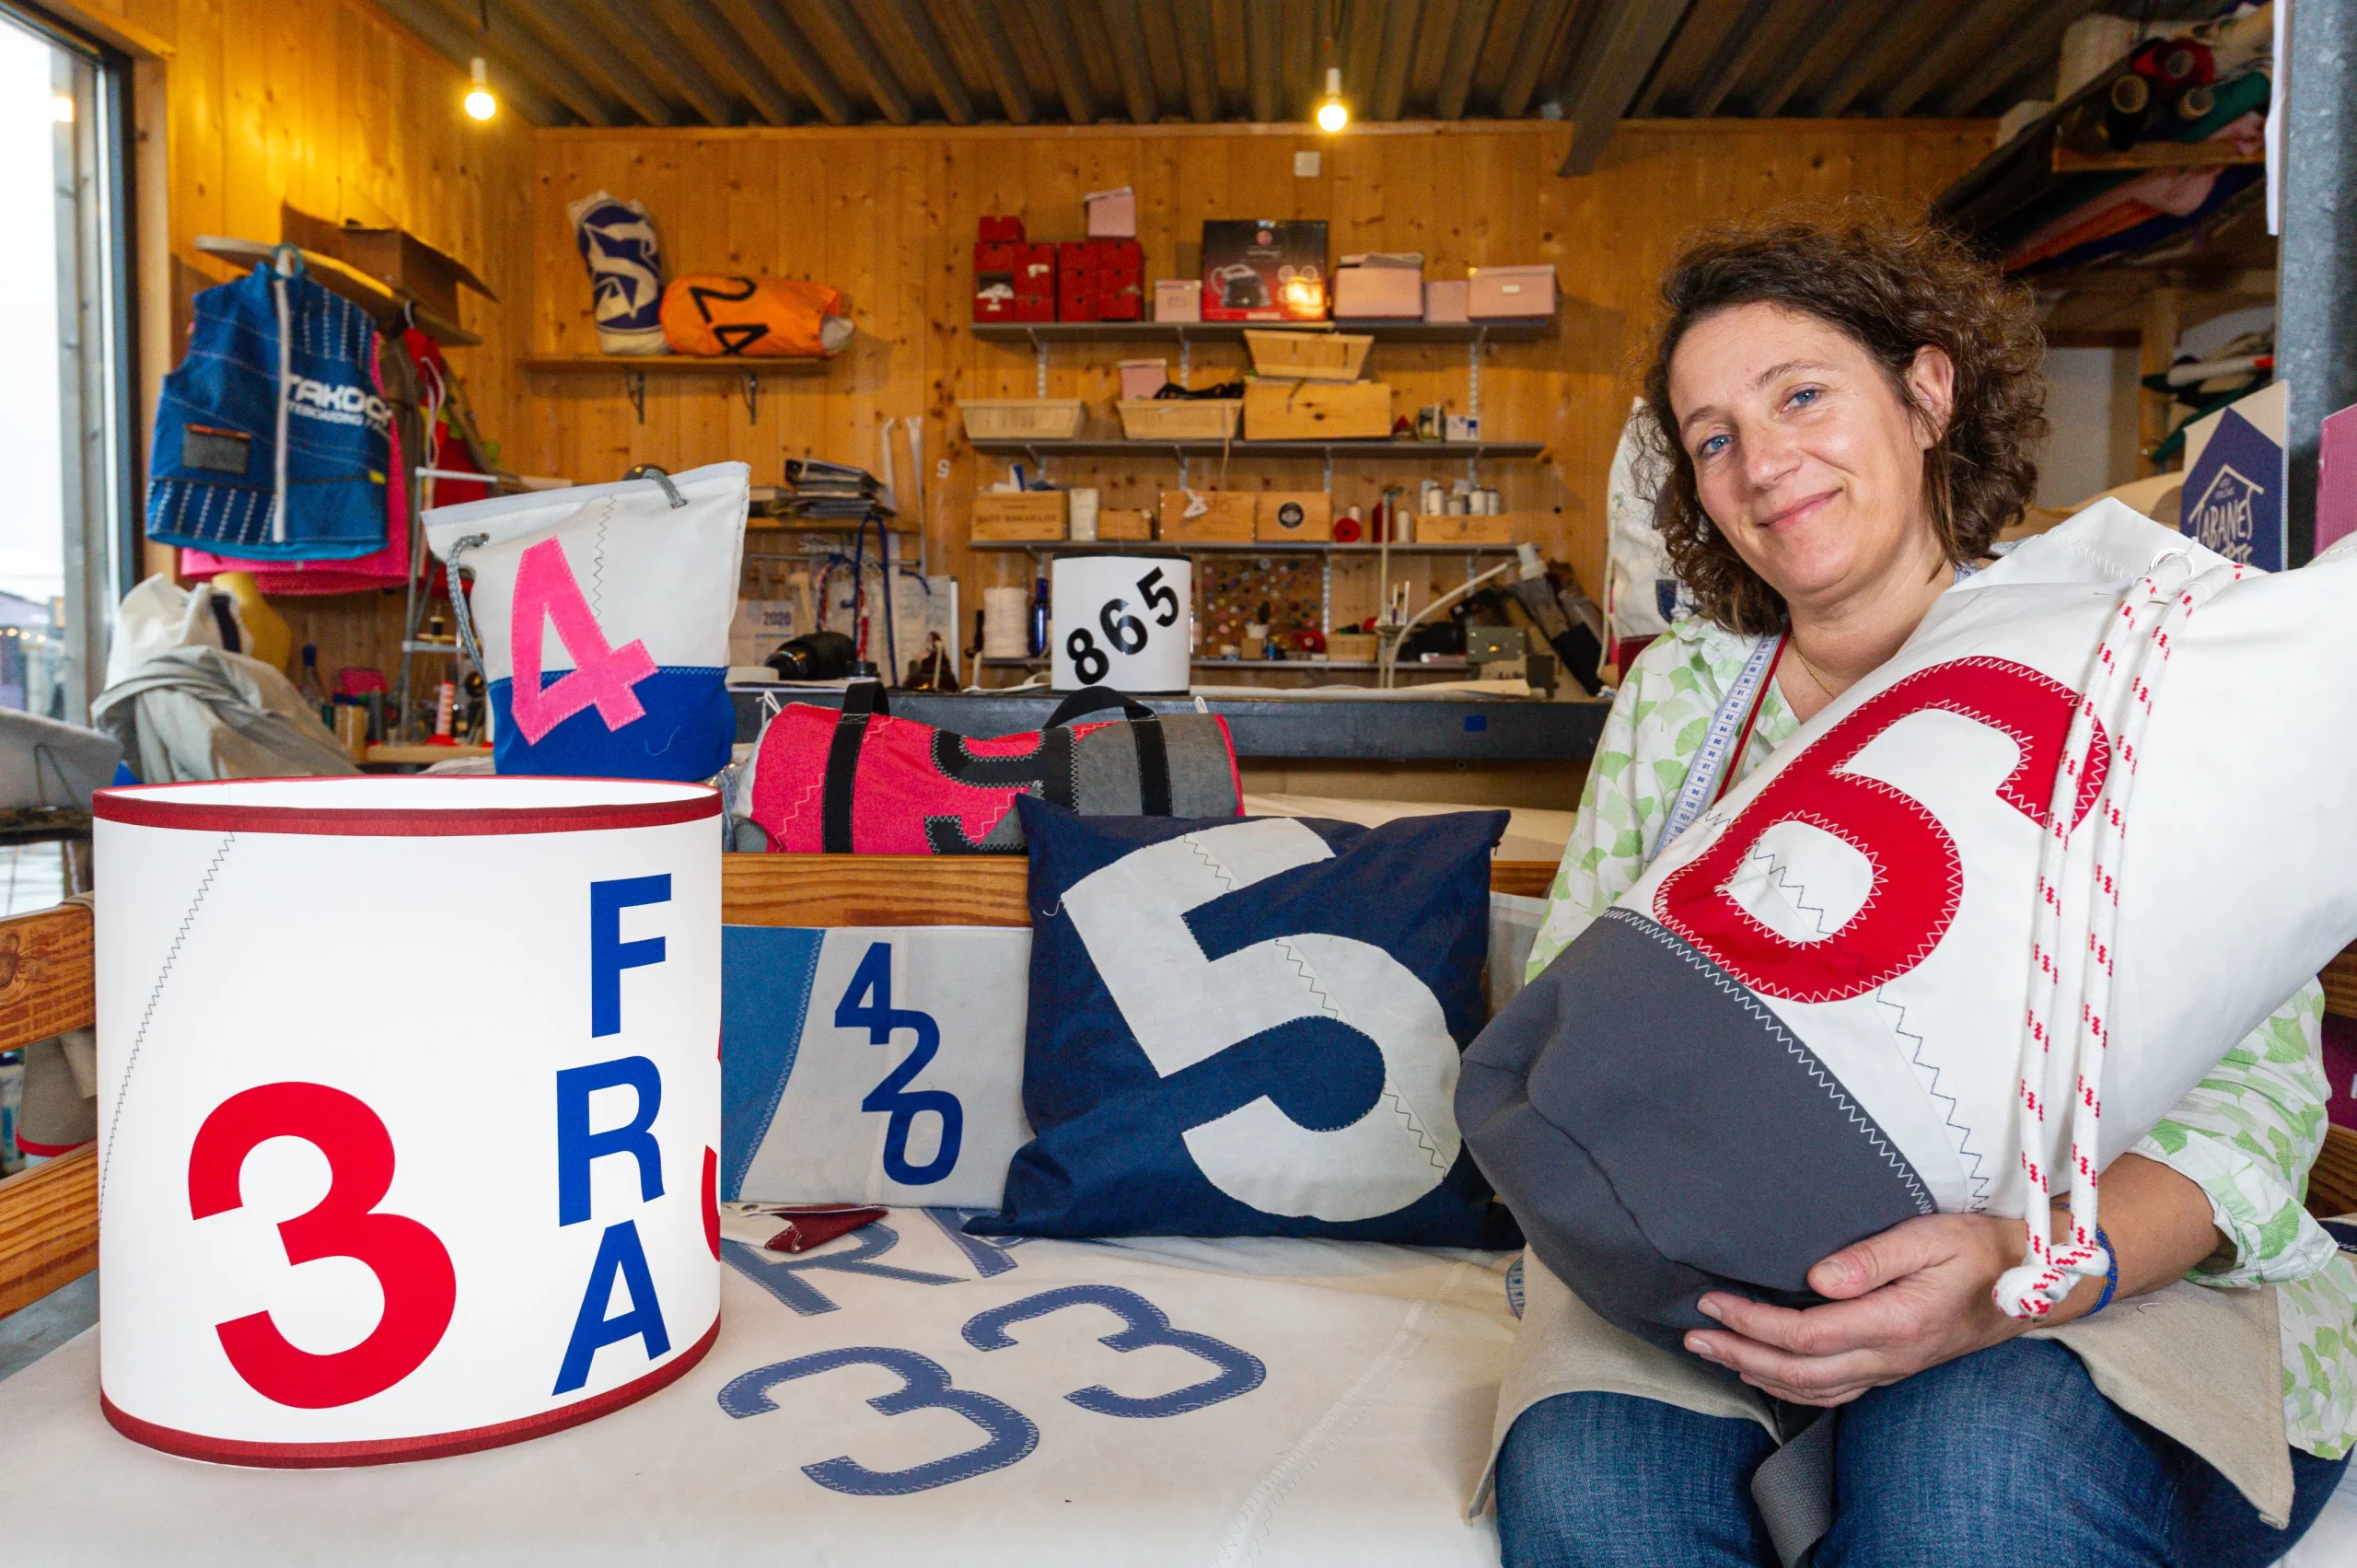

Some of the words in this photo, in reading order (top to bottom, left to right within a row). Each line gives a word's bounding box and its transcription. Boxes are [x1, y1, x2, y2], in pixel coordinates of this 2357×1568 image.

[287, 372, 393, 426] TAKOO
[511, 537, 657, 747] 4
[1066, 566, 1179, 685] 865
[1655, 656, 2110, 1004] 6
[1679, 812, 1690, 822] 101
[1685, 800, 1696, 809] 100
[1702, 762, 1711, 771] 97
[834, 942, 963, 1186] 420
[1060, 817, 1460, 1219] 5
[552, 874, 673, 1395] FRA
[189, 1081, 457, 1409] 3
